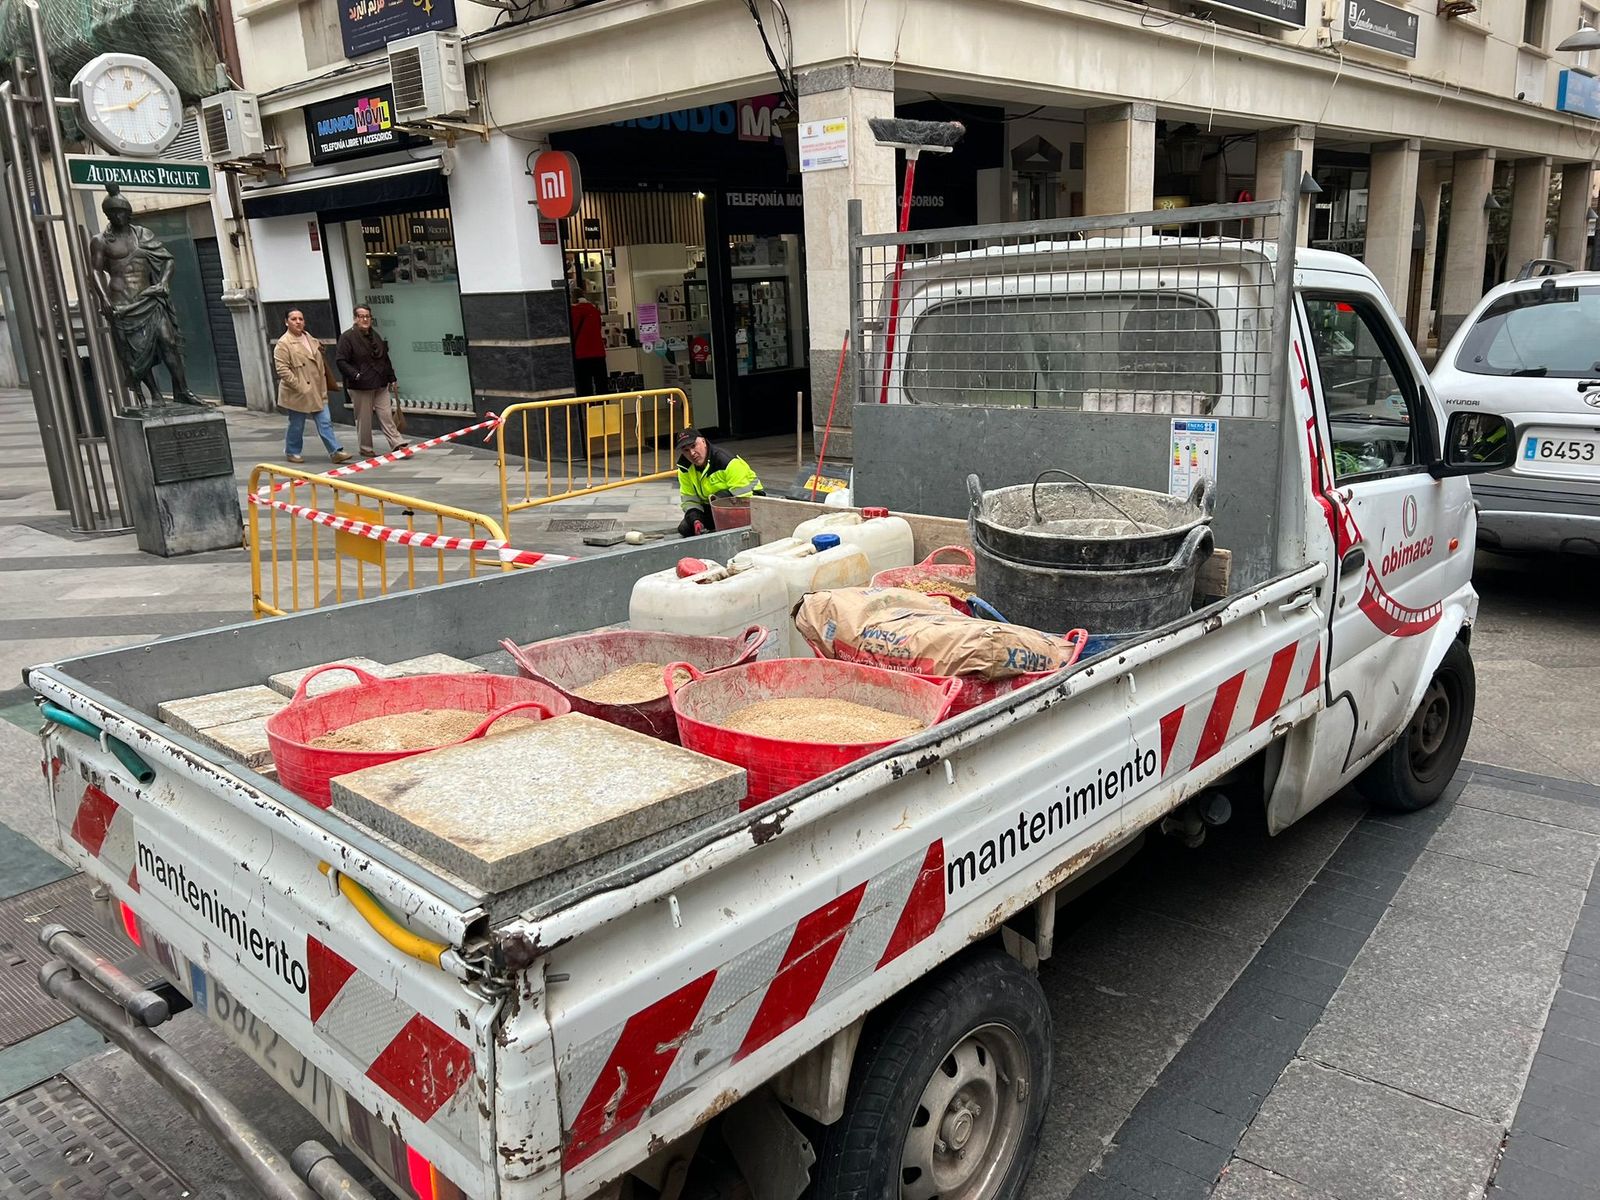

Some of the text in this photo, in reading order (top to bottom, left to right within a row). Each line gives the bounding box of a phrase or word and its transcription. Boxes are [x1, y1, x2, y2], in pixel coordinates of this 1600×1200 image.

[317, 114, 356, 136] MUNDO
[608, 102, 736, 134] UNDO
[320, 138, 346, 153] TELEFONÍA
[346, 137, 359, 148] LIBRE
[363, 131, 393, 144] ACCESORIOS
[87, 165, 200, 185] AUDEMARS PIGUET
[726, 190, 785, 207] TELEFONÍA
[1541, 440, 1595, 461] 6453
[1381, 535, 1434, 577] obimace
[947, 748, 1157, 895] mantenimiento
[137, 840, 307, 995] mantenimiento
